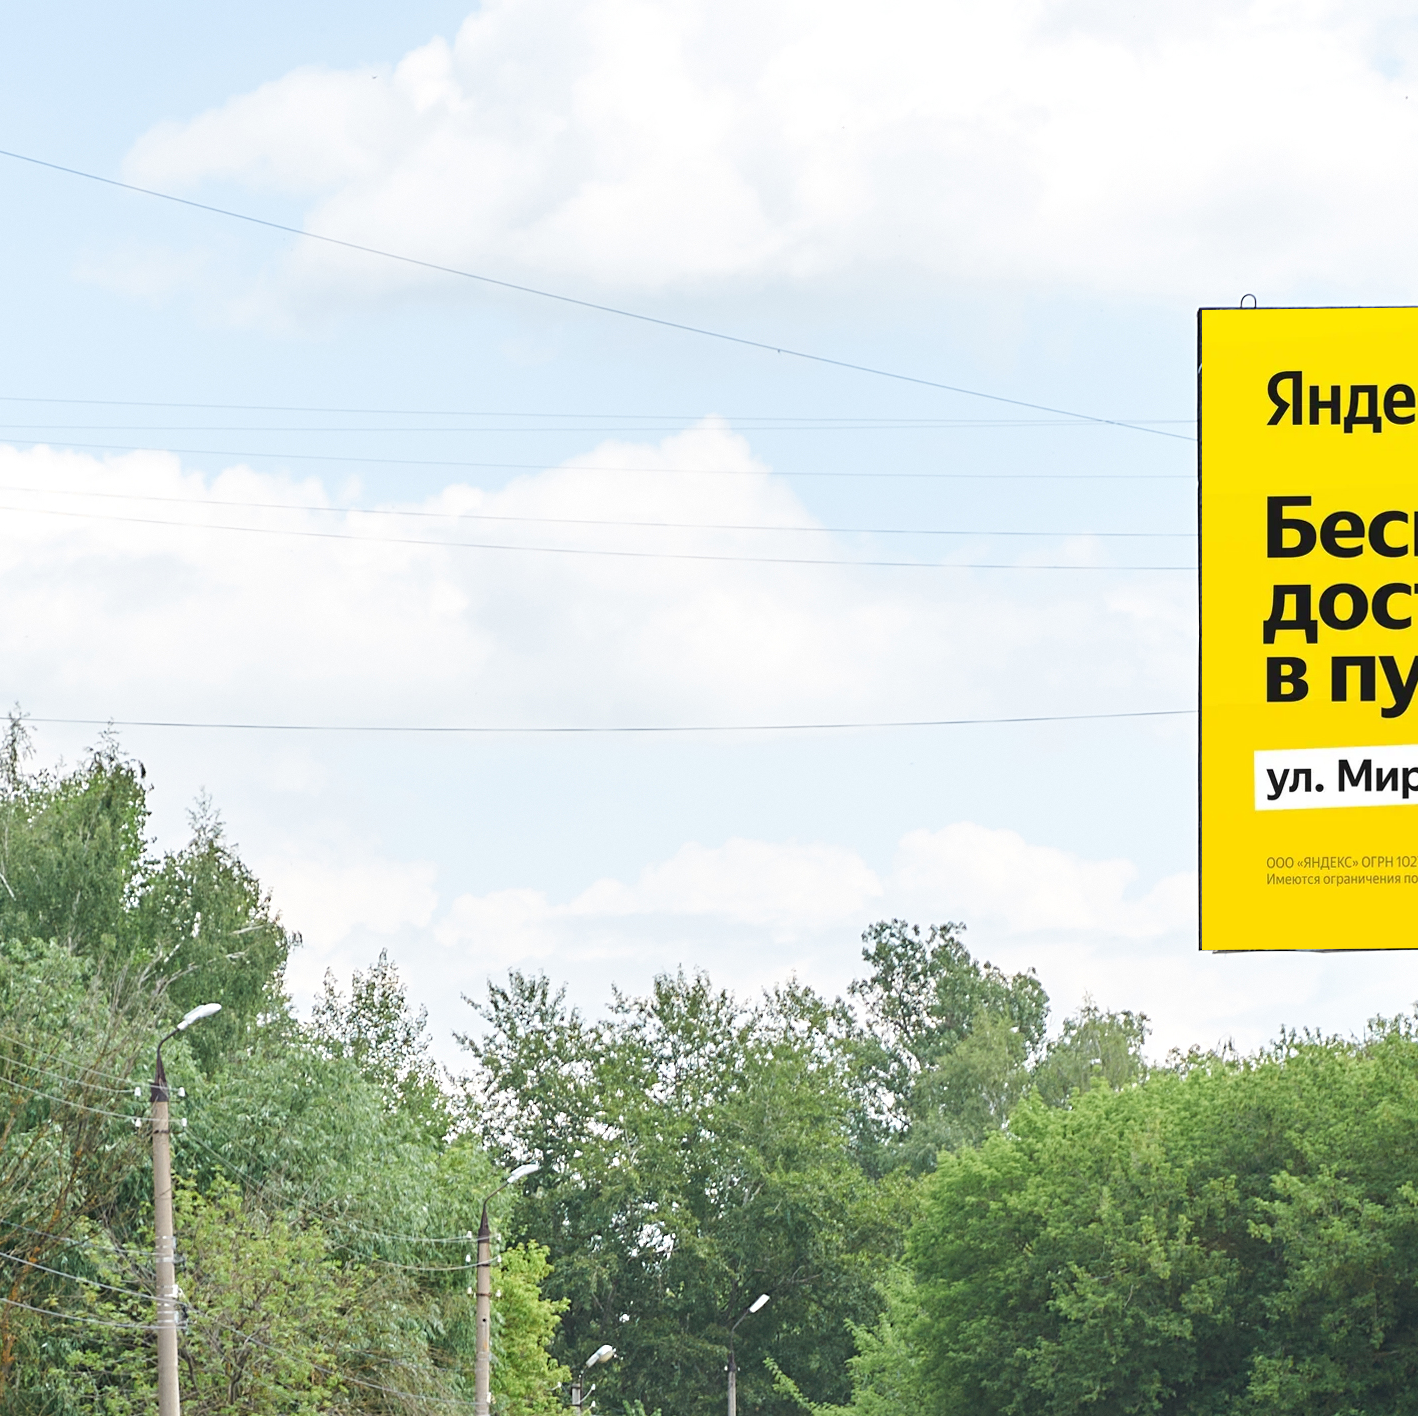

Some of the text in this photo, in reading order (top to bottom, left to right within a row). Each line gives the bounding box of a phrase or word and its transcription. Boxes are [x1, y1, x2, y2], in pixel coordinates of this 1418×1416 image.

[1266, 656, 1309, 703] в
[1266, 768, 1324, 801] ул.
[1266, 856, 1295, 869] ООО
[1297, 856, 1359, 871] «ЯНДЕКС»
[1361, 855, 1394, 868] ОГРН
[1266, 873, 1321, 885] Имеются
[1323, 874, 1401, 887] ограничения
[1404, 874, 1418, 884] по
